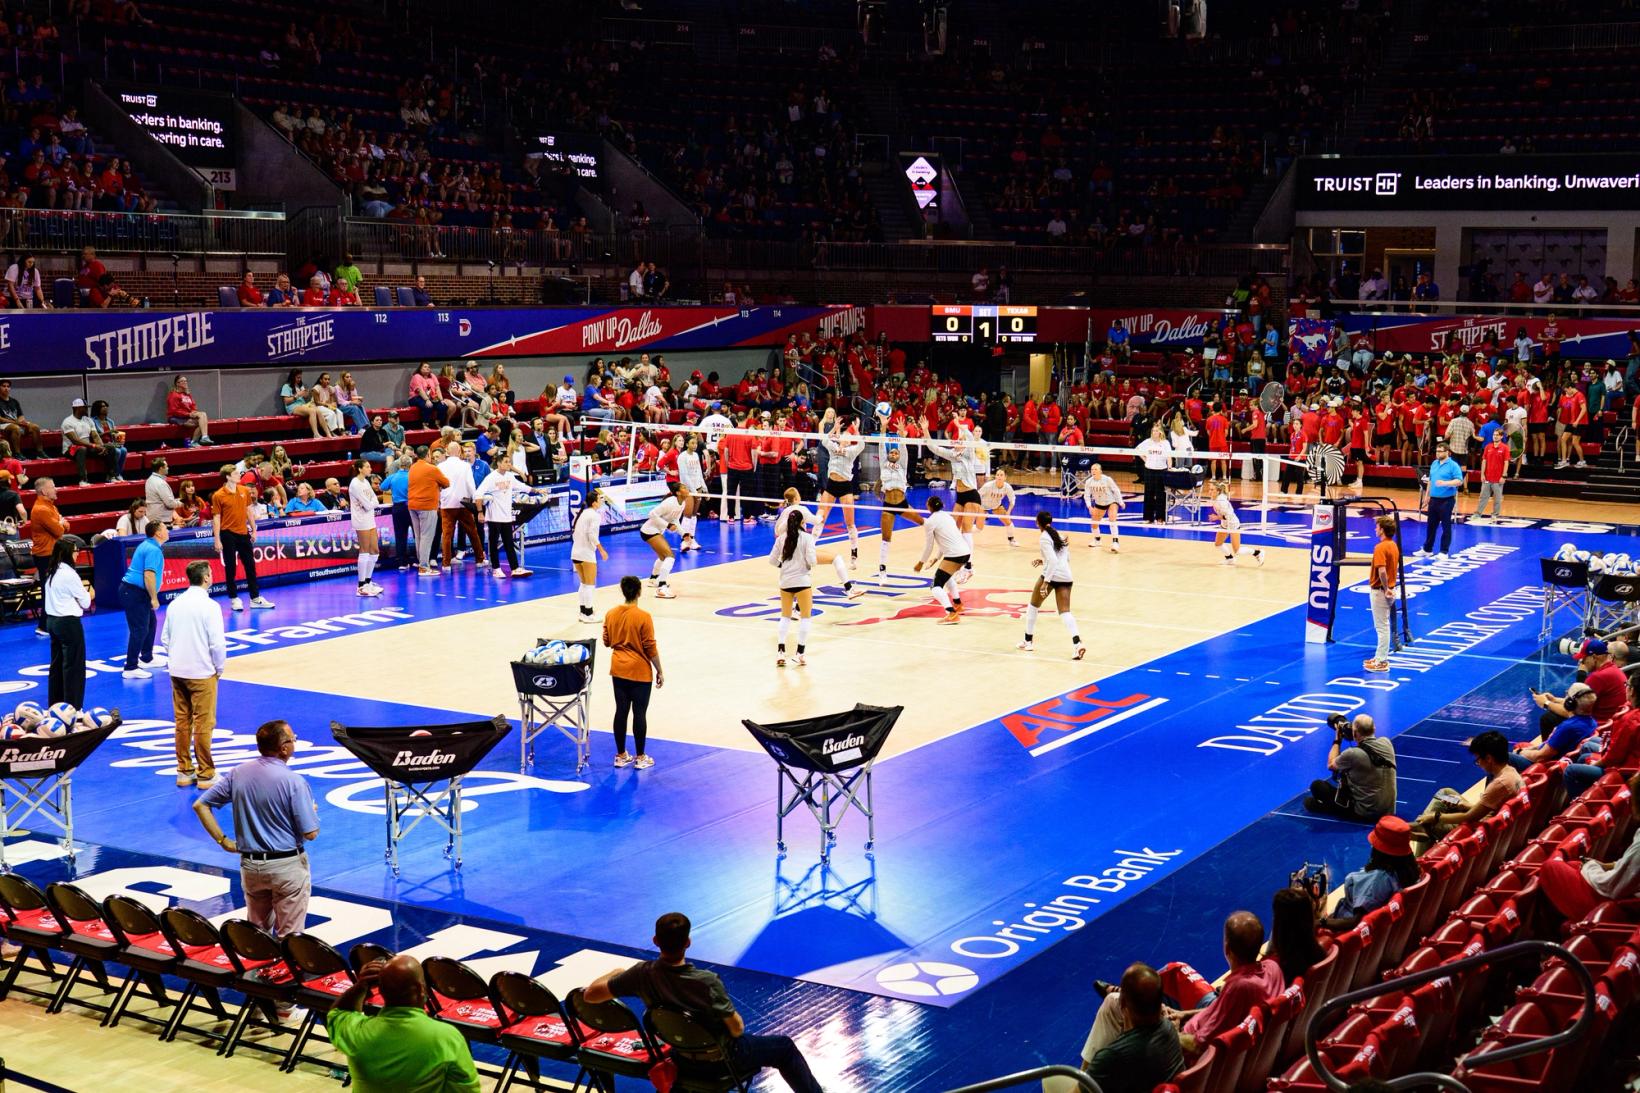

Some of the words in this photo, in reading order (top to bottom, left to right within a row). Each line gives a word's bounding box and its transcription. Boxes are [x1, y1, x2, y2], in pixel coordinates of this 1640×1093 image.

[121, 94, 146, 104] TRUIST
[166, 115, 177, 128] in
[178, 116, 223, 134] banking.
[188, 133, 198, 146] in
[199, 137, 225, 148] care.
[210, 171, 231, 184] 213
[1313, 177, 1373, 192] TRUIST
[1415, 175, 1474, 190] Leaders
[1477, 175, 1491, 189] in
[1495, 174, 1561, 192] banking.
[296, 316, 306, 327] THE
[375, 313, 388, 323] 112
[438, 313, 450, 322] 113
[946, 317, 959, 332] 0
[1011, 317, 1023, 332] 0
[1463, 319, 1474, 327] THE
[582, 321, 605, 348] PONY
[606, 316, 617, 340] UP
[615, 310, 663, 348] Dallas
[979, 321, 990, 338] 1
[1140, 313, 1154, 333] UP
[1151, 313, 1209, 344] Dallas
[84, 311, 215, 371] STAMPEDE
[267, 319, 335, 357] STAMPEDE
[195, 529, 213, 539] UTSW
[1308, 544, 1334, 610] SMU
[1196, 692, 1366, 757] DAVID
[1326, 675, 1412, 692] B.
[1385, 620, 1511, 674] MILLER
[1000, 684, 1151, 749] ACC
[822, 732, 865, 756] Baden
[0, 747, 67, 764] Baden
[391, 749, 457, 767] Baden
[950, 894, 1101, 960] Origin
[1062, 846, 1184, 893] Bank
